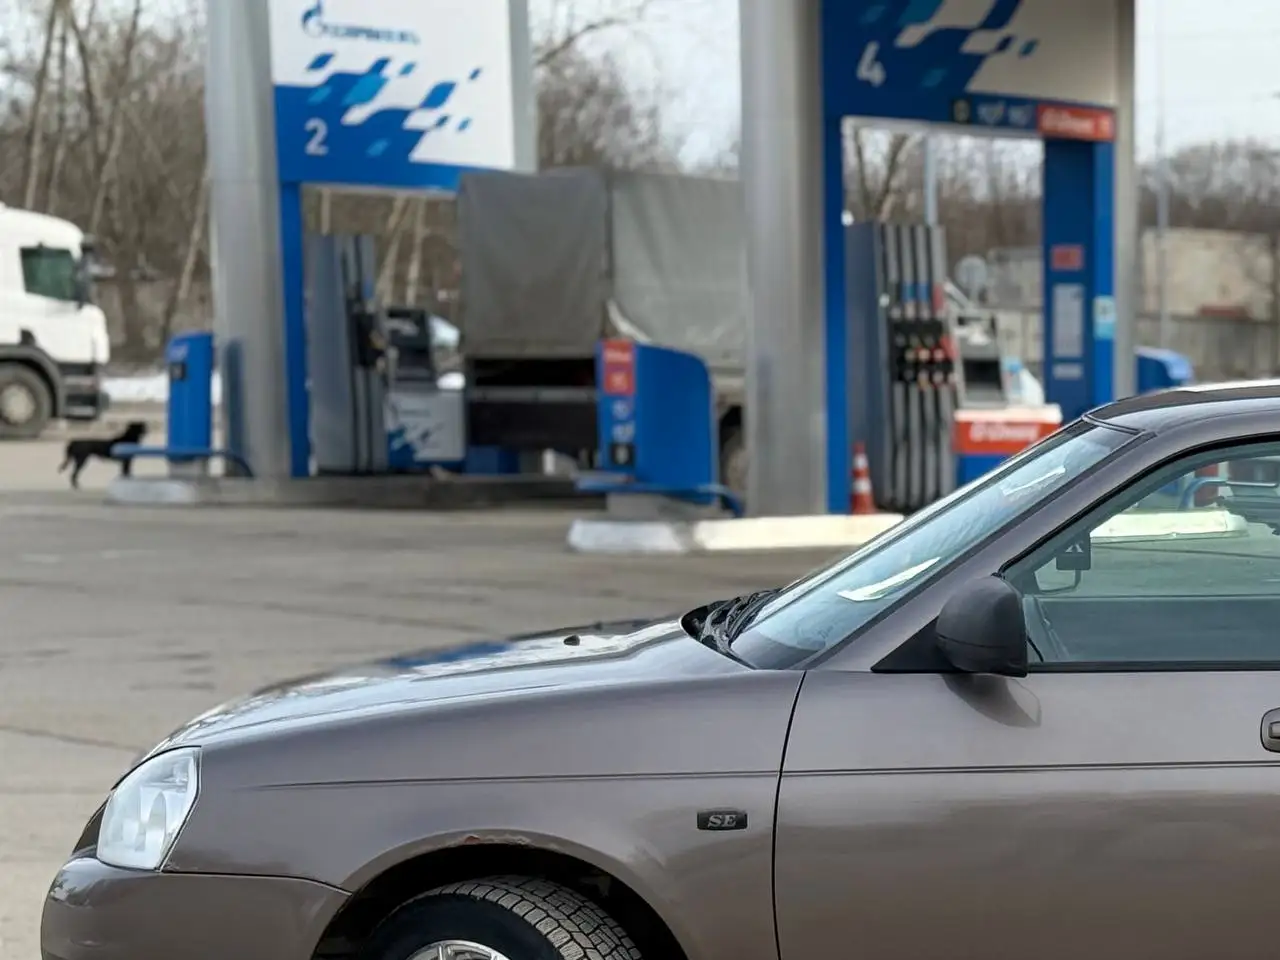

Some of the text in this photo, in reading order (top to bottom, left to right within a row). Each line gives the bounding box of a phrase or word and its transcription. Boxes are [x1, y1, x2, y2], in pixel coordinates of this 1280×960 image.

[856, 40, 887, 87] 4
[304, 117, 329, 155] 2
[708, 815, 737, 828] SE
